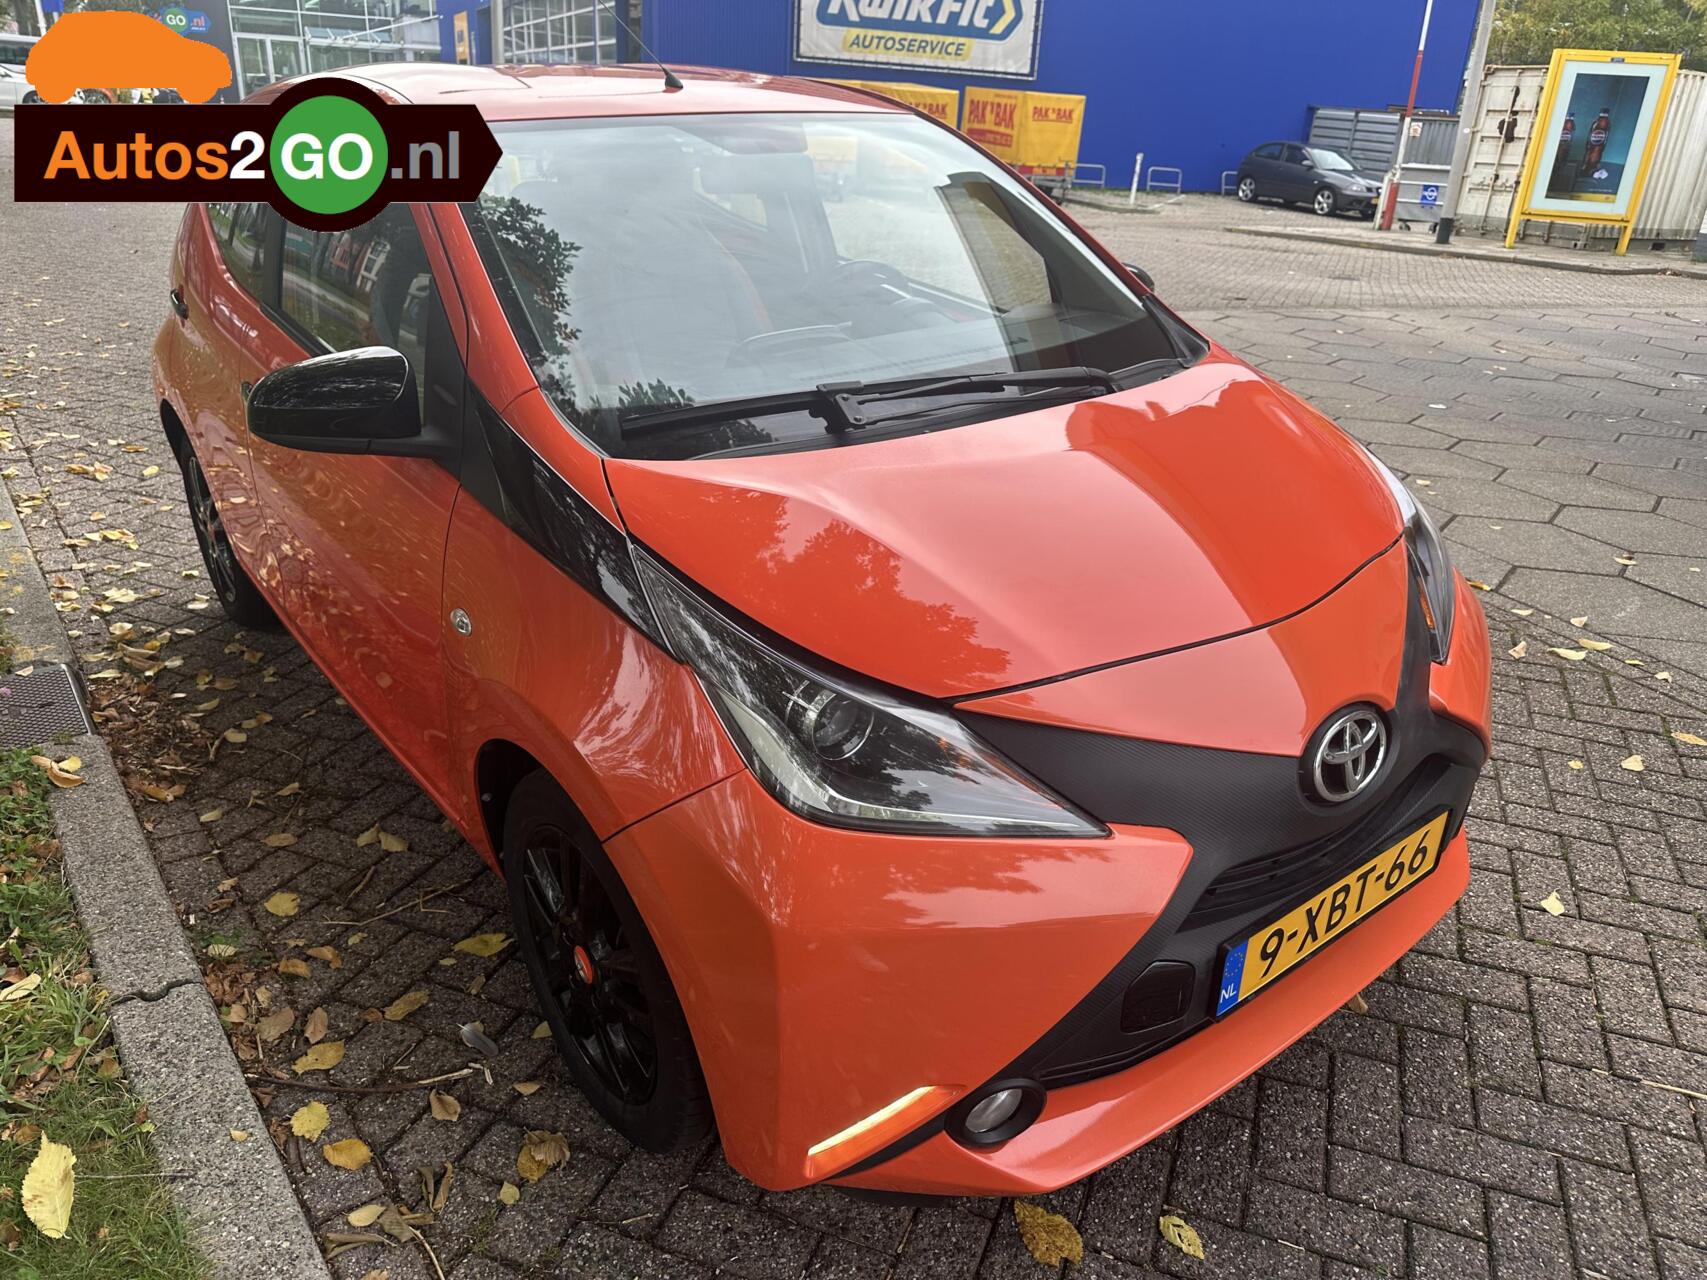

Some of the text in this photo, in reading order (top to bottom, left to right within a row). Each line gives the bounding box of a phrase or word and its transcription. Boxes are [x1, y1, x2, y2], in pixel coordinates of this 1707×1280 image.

[848, 34, 966, 57] AUTOSERVICE
[968, 99, 988, 124] PAK
[994, 102, 1017, 130] BAK
[1032, 106, 1050, 120] PAK
[1056, 108, 1074, 122] BAK
[1260, 829, 1431, 979] 9-XBT-66
[1220, 982, 1238, 1003] NL
